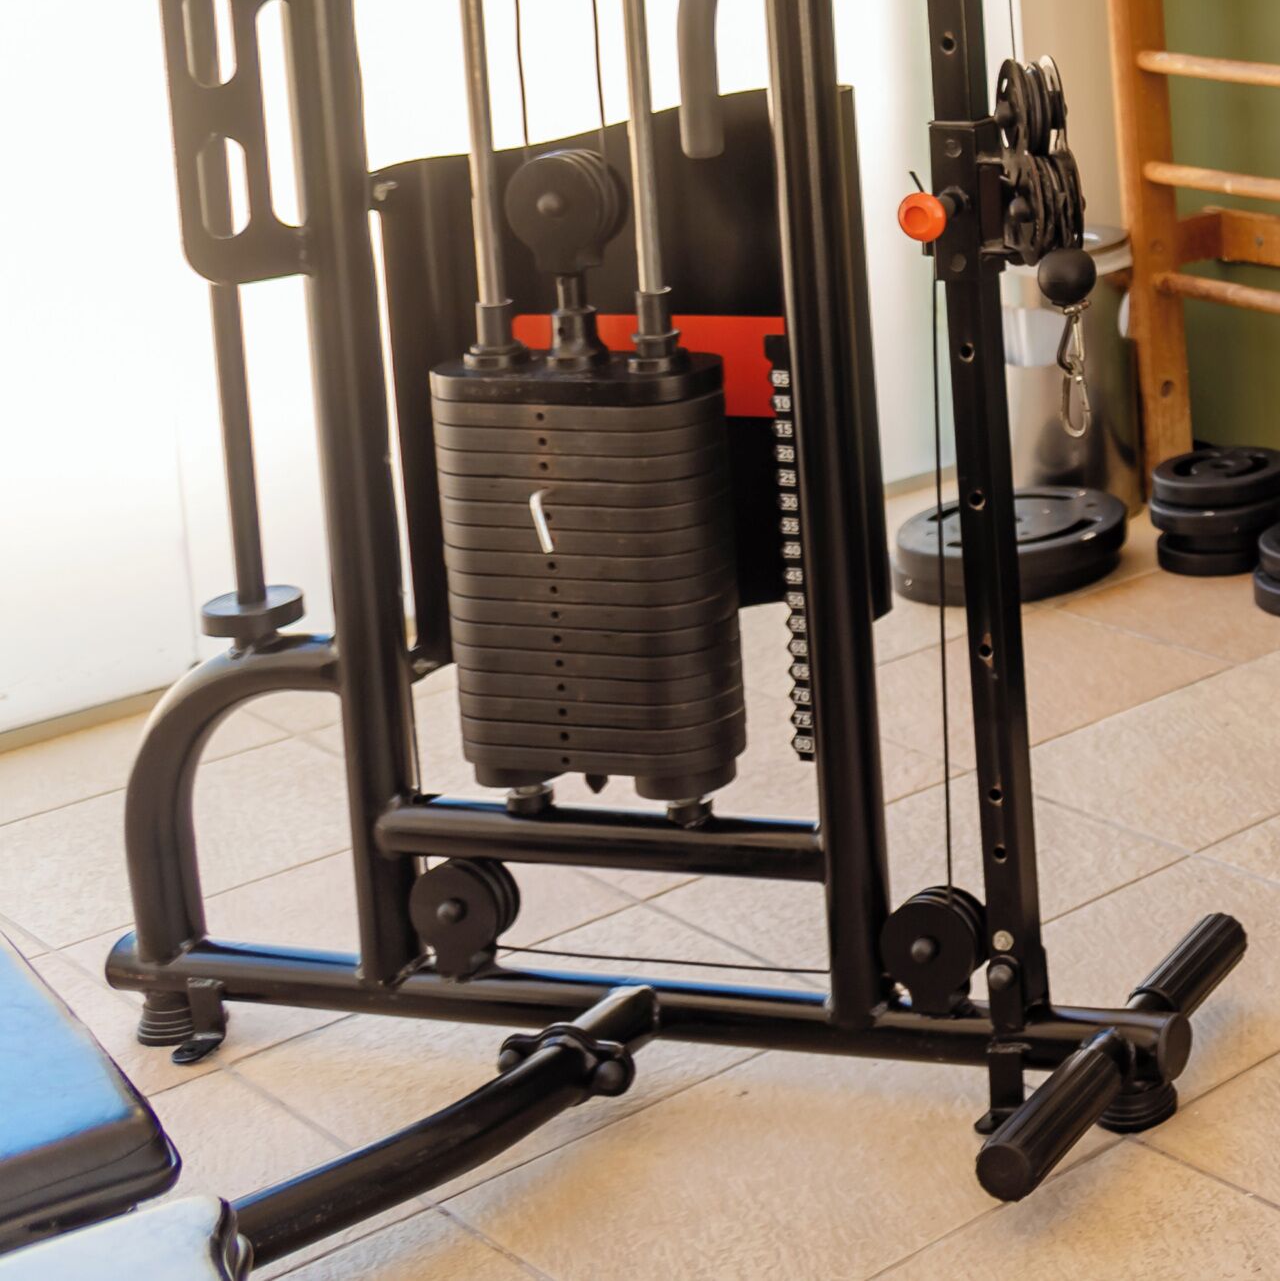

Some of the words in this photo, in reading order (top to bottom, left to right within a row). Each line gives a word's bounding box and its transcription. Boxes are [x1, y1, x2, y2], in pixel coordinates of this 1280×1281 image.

[771, 373, 790, 385] 05
[774, 398, 791, 409] 10
[776, 423, 793, 435] 15
[777, 448, 795, 460] 20
[779, 472, 797, 484] 25
[781, 497, 798, 508] 30
[782, 521, 800, 532] 35
[783, 545, 801, 556] 40
[785, 571, 803, 582] 45
[792, 666, 810, 678] 65
[793, 690, 810, 702] 70
[794, 714, 811, 726] 75
[794, 738, 811, 751] 80
